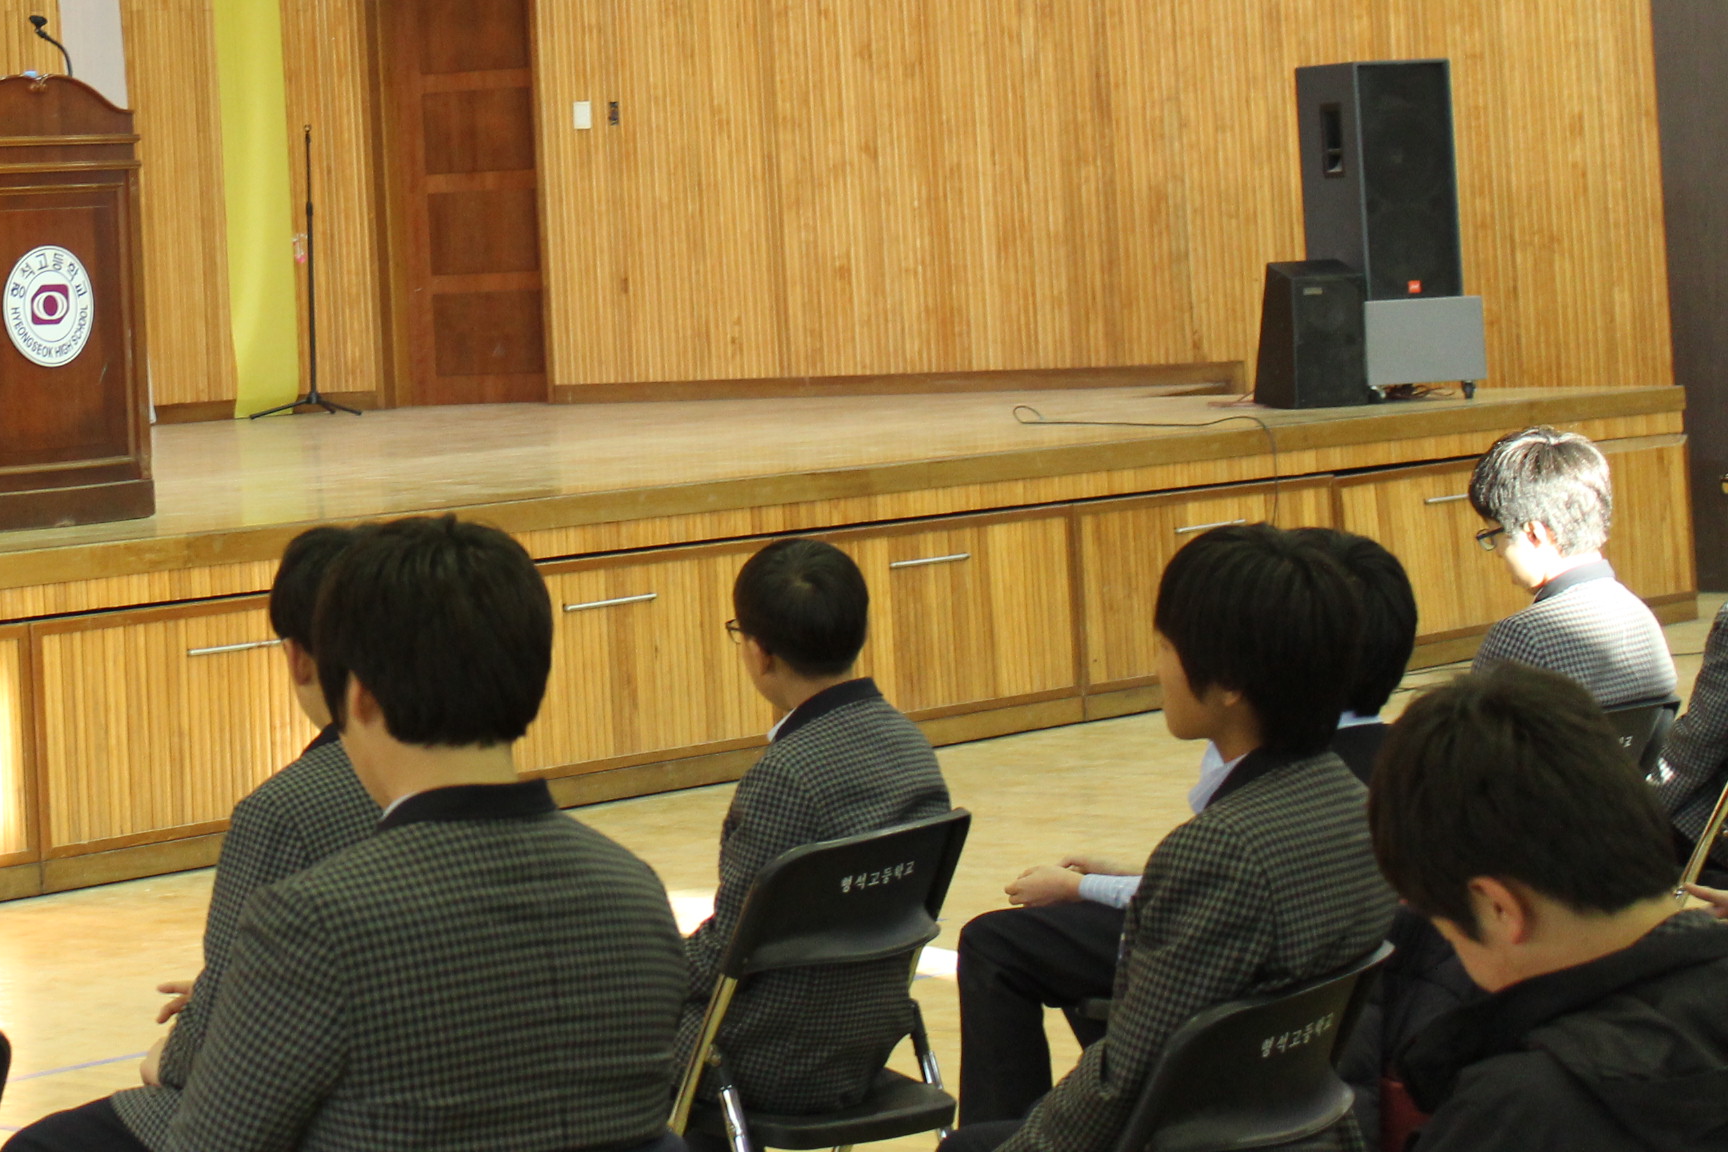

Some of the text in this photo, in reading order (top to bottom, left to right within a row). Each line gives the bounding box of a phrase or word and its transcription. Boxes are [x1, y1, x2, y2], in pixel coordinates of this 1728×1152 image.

[11, 305, 89, 358] HYEONGSEOK HIGH SCHOOL
